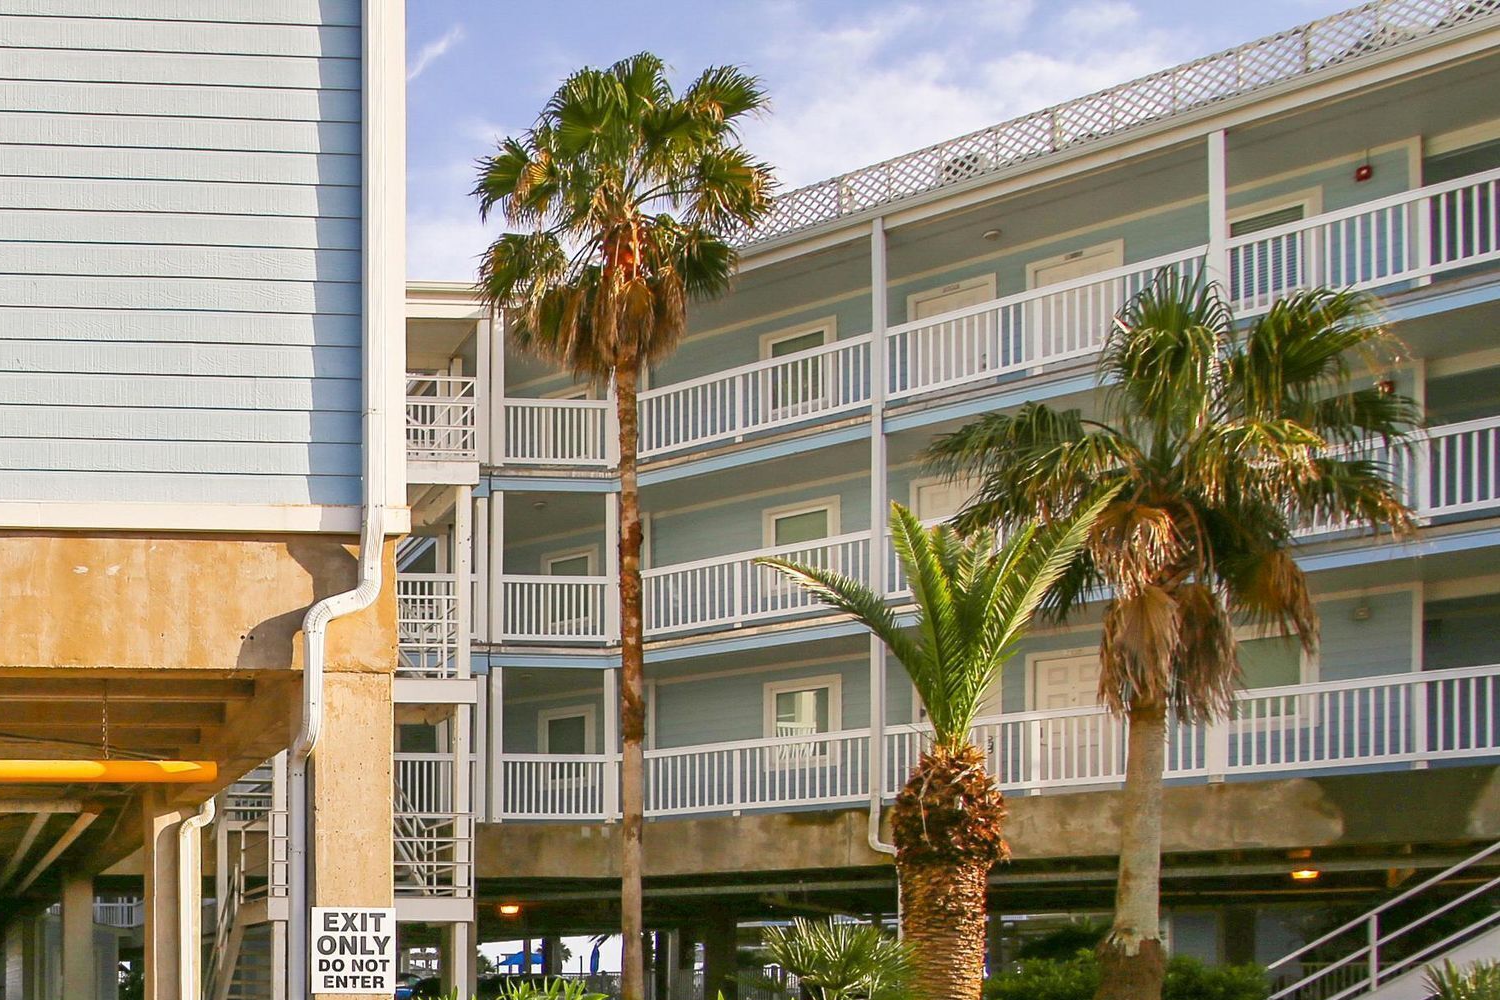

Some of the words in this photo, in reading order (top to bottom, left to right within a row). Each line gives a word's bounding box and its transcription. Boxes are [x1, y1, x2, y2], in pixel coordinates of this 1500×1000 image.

[323, 912, 386, 932] EXIT
[316, 935, 391, 955] ONLY
[318, 959, 345, 972] DO
[351, 959, 390, 972] NOT
[323, 975, 385, 988] ENTER
